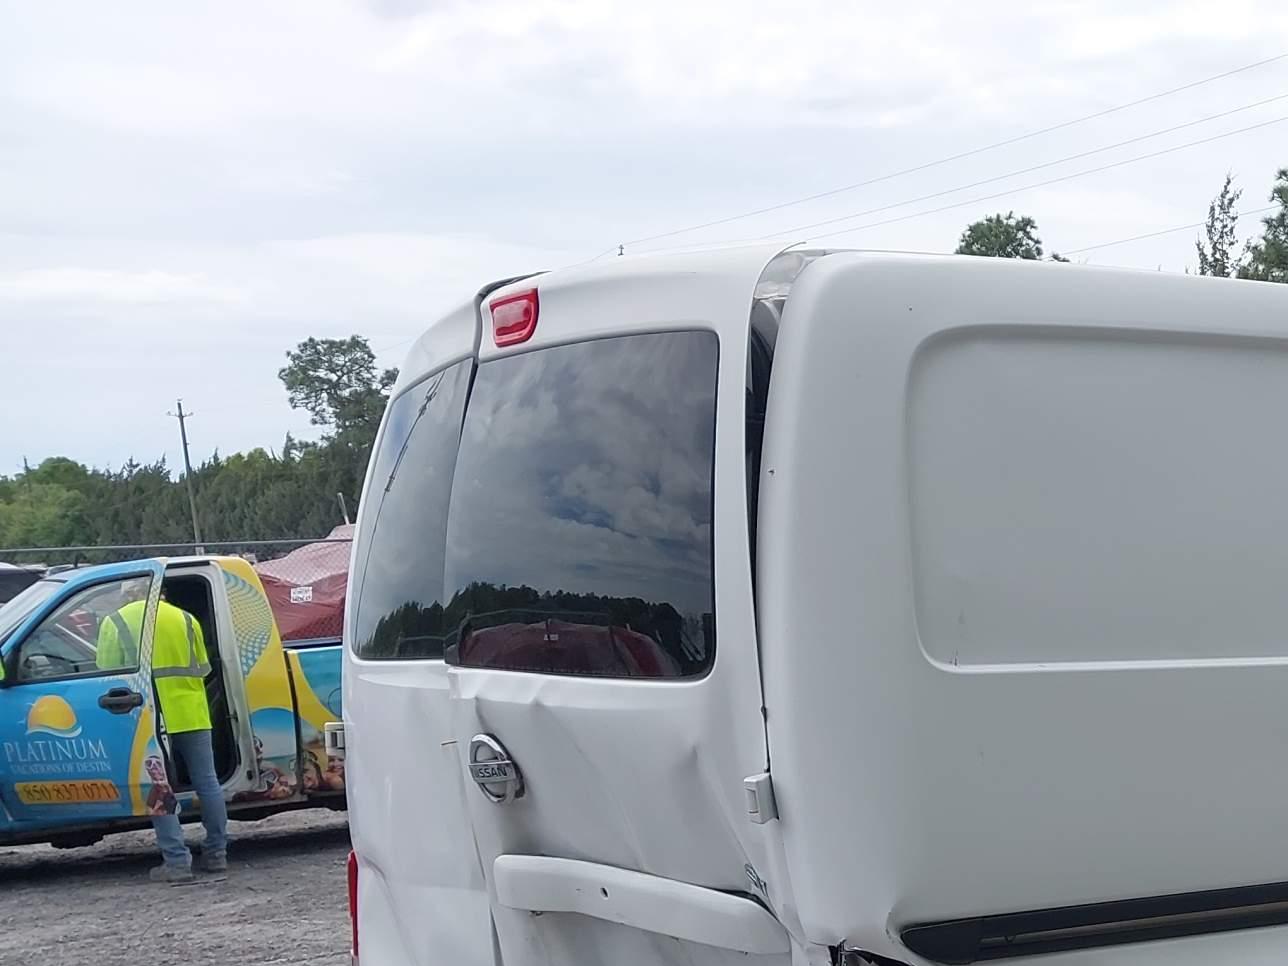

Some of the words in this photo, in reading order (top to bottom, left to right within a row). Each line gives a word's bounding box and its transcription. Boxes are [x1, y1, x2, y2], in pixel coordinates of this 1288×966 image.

[3, 739, 109, 762] PLATINUM
[62, 763, 73, 774] OF
[75, 761, 112, 773] DESTIN
[23, 784, 51, 801] 850
[54, 783, 80, 801] 837
